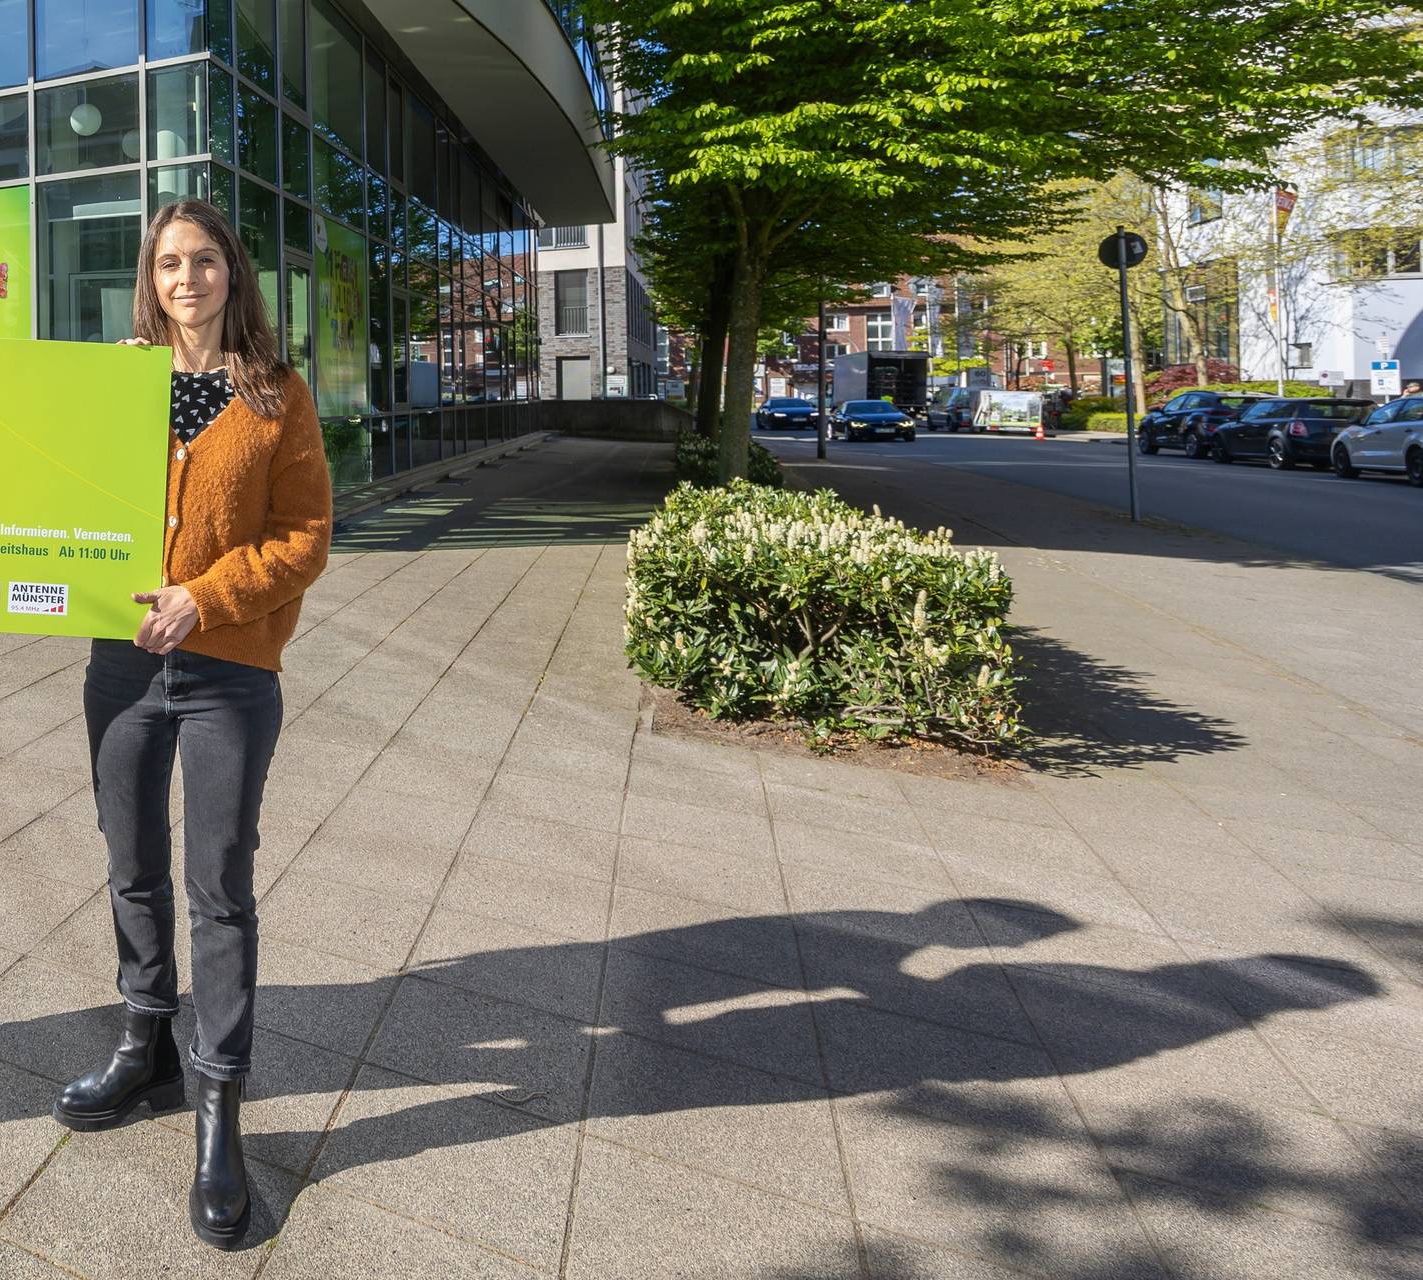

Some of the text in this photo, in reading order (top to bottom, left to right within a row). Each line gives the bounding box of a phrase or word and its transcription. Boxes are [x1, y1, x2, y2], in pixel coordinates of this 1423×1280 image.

[0, 523, 70, 539] Informieren.
[73, 527, 135, 543] Vernetzen.
[59, 545, 75, 558] Ab
[79, 547, 106, 560] 11:00
[110, 548, 131, 561] Uhr
[12, 584, 65, 595] ANTENNE
[11, 592, 64, 604] MÜNSTER
